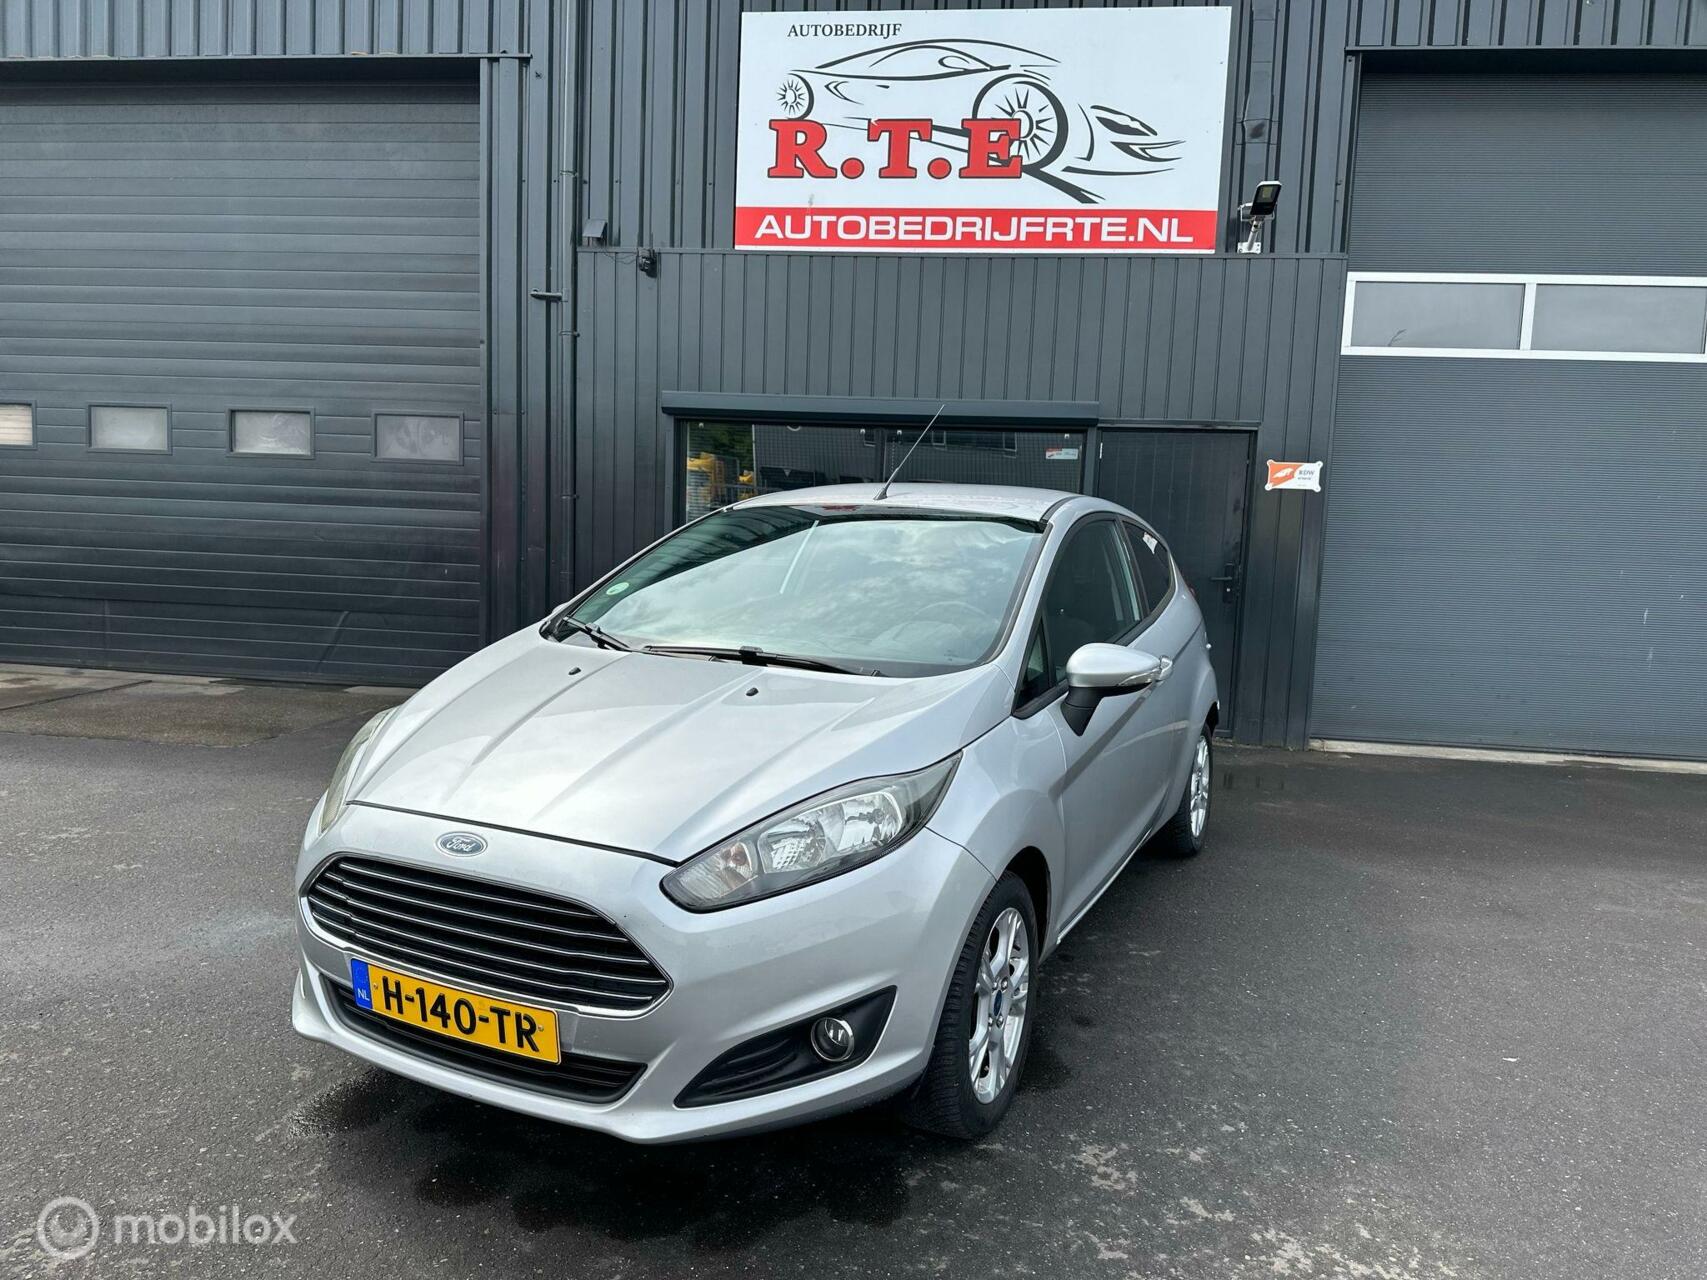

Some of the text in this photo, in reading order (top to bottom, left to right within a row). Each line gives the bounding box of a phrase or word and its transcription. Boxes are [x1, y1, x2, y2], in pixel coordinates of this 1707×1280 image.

[787, 23, 902, 39] AUTOBEDRIJF
[768, 118, 1023, 180] R.T.E
[754, 213, 1194, 244] AUTOBEDRIJFRTE.NL
[446, 836, 477, 852] Ford
[357, 988, 370, 1001] NL
[382, 975, 540, 1052] H-140-TR
